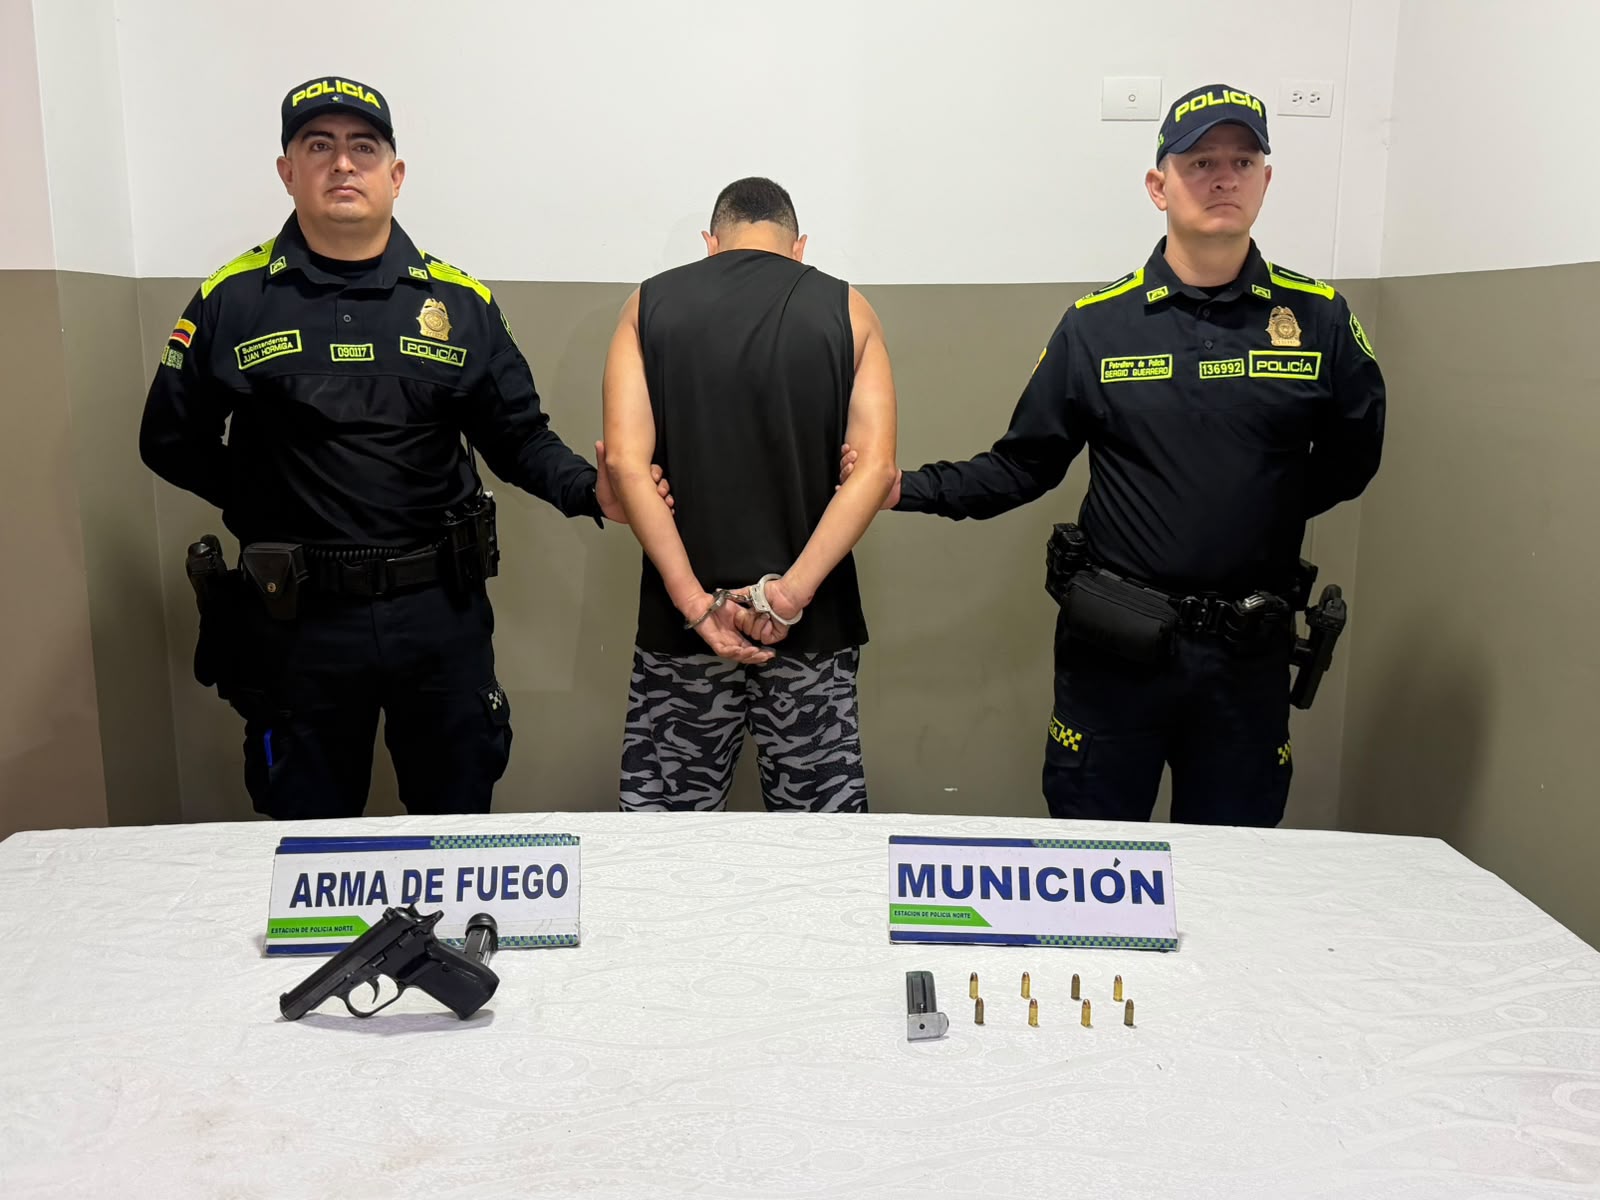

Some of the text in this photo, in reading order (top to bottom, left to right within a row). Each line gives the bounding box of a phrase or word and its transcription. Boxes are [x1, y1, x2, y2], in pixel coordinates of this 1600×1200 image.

[243, 341, 294, 363] JUAN HORMIGA
[1105, 366, 1168, 378] SERGIO GUERRERO
[1202, 362, 1242, 375] 136992
[1256, 358, 1313, 373] POLICÍA
[289, 863, 570, 908] ARMA DE FUEGO
[897, 857, 1165, 905] MUNICIÓN
